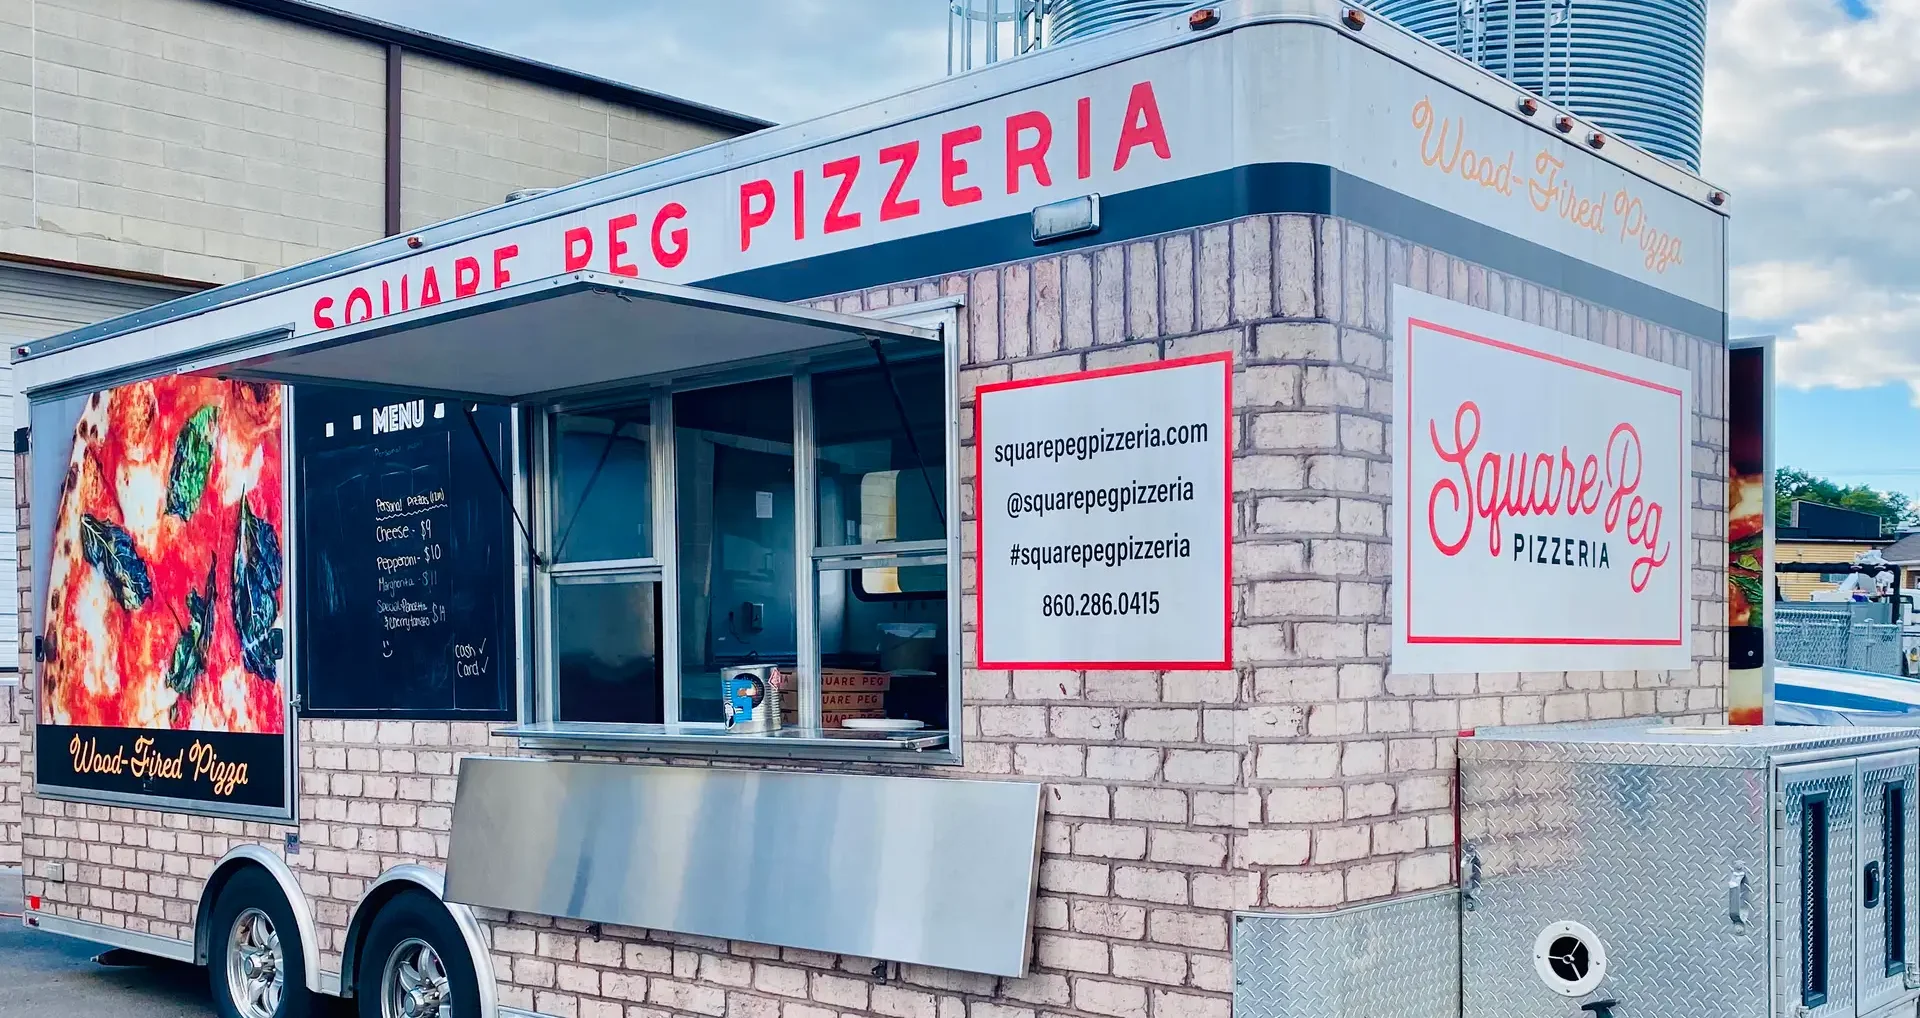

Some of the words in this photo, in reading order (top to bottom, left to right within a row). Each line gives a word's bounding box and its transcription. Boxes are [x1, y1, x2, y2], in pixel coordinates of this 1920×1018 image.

[1411, 96, 1605, 234] Wood-Fired
[1613, 187, 1683, 274] Pizza
[314, 245, 519, 329] SQUARE
[565, 202, 689, 277] PEG
[739, 82, 1172, 252] PIZZERIA
[372, 399, 425, 435] MENU
[994, 421, 1208, 467] squarepegpizzeria.com
[1006, 475, 1194, 519] @squarepegpizzeria
[1428, 400, 1604, 557] Square
[1604, 422, 1672, 594] Peg
[376, 525, 409, 542] Cheese
[420, 519, 433, 540] $9
[423, 544, 442, 564] $10
[1010, 532, 1190, 571] #squarepegpizzeria
[1514, 532, 1610, 569] PIZZERIA
[1042, 590, 1160, 617] 860.286.0415
[457, 660, 480, 678] Card
[820, 676, 856, 686] UARE
[862, 676, 884, 686] PEG
[821, 695, 852, 705] UARE
[856, 695, 878, 704] PEG
[69, 733, 185, 779] Wood-Fired
[188, 739, 249, 797] Pizza
